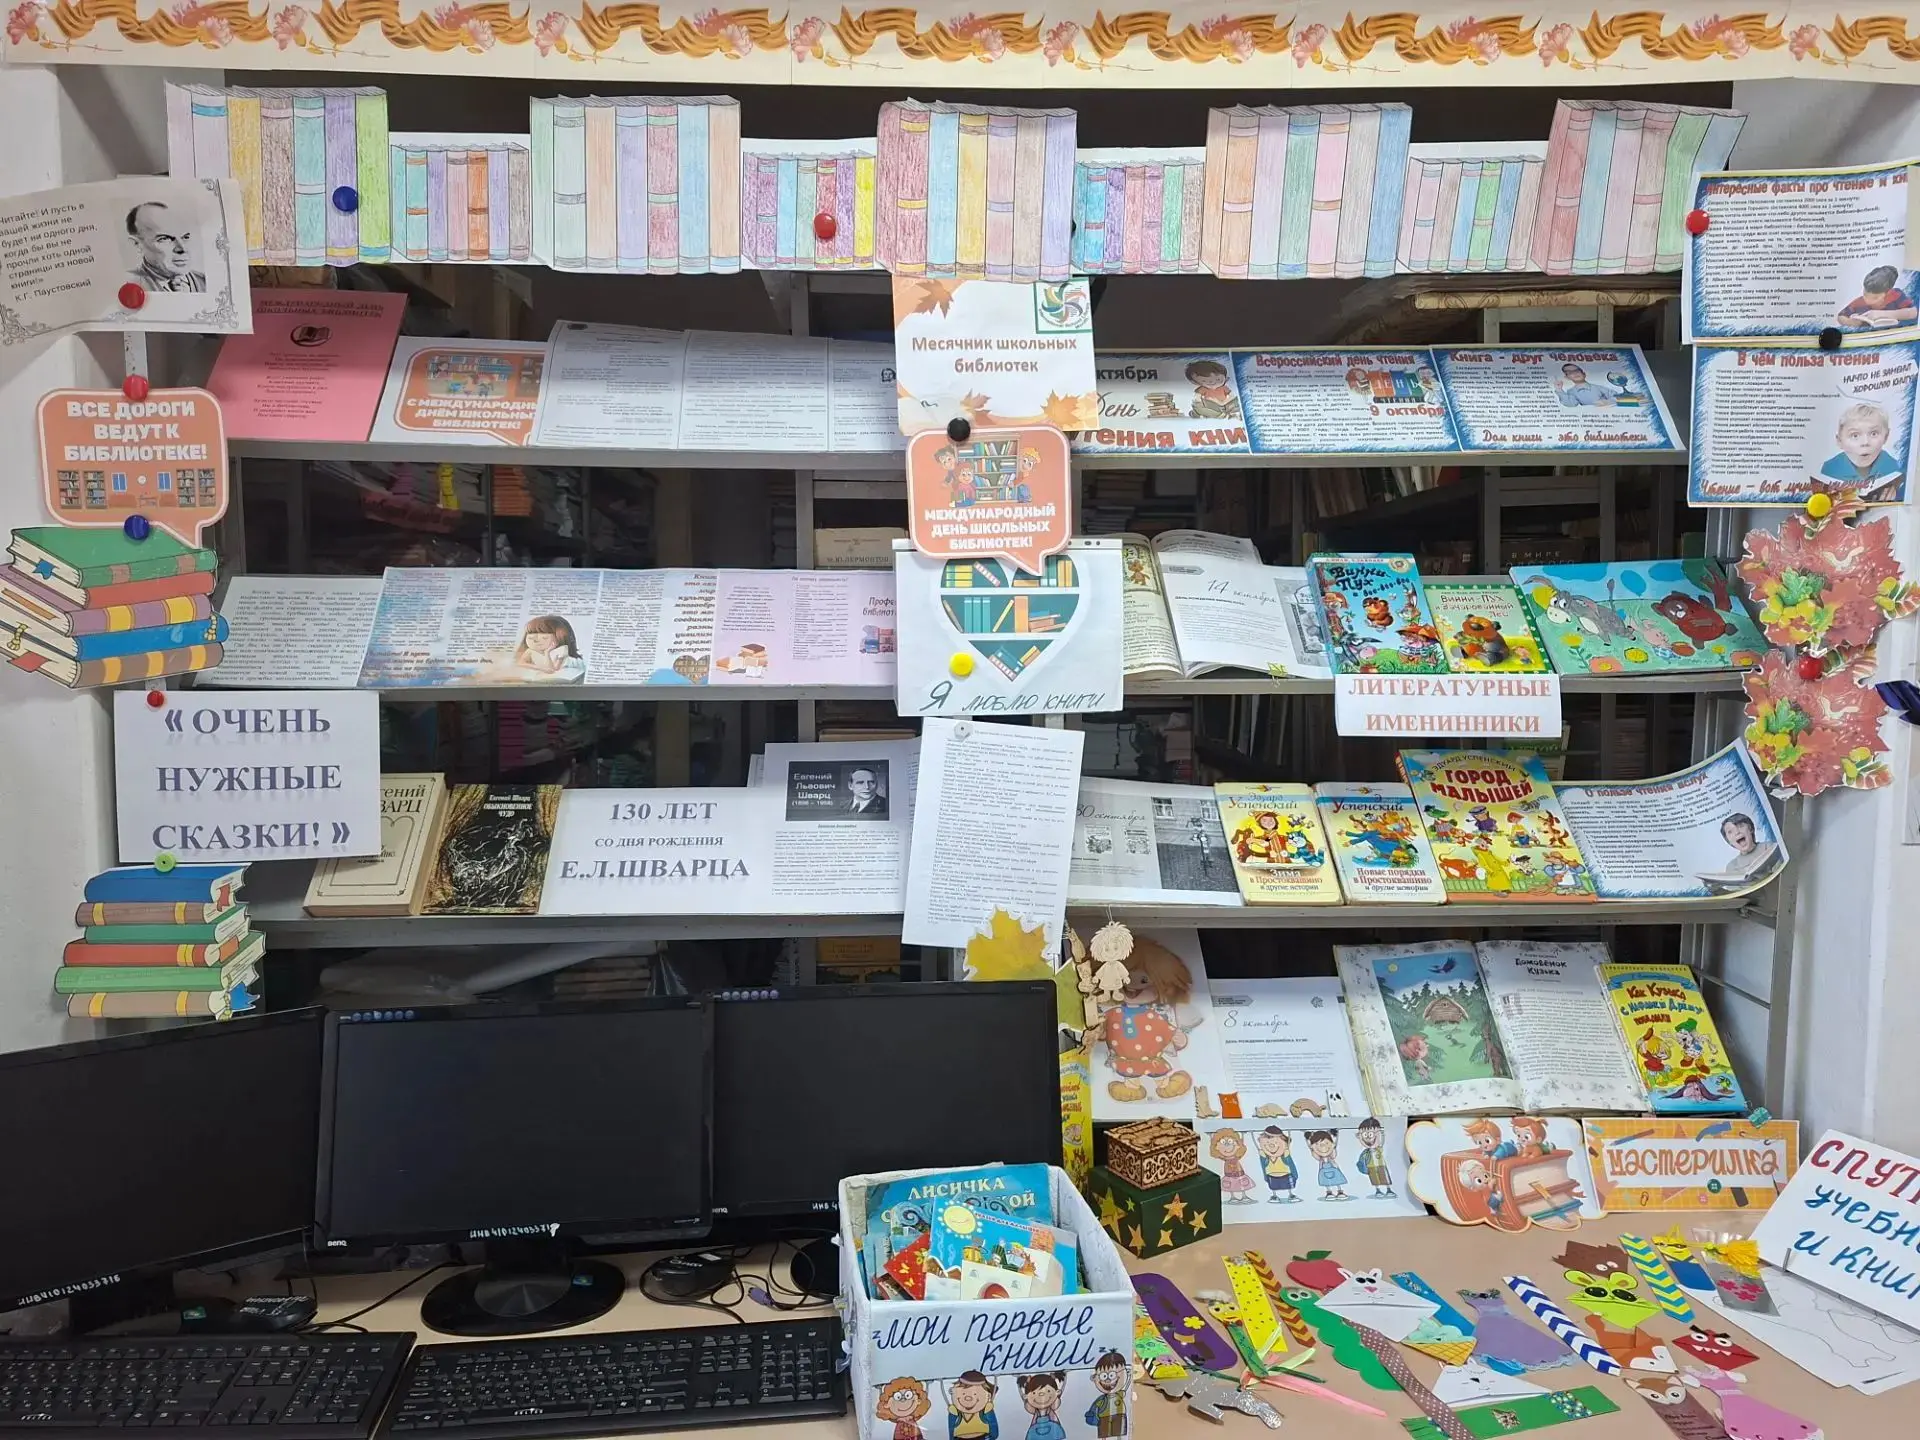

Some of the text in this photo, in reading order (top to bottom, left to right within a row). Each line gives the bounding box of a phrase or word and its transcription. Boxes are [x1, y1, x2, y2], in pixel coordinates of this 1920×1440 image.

[1772, 182, 1805, 195] факты
[1810, 181, 1828, 195] про
[1833, 178, 1873, 191] чтение
[1879, 177, 1887, 187] и
[40, 207, 49, 217] И
[50, 204, 77, 215] пусть
[31, 218, 60, 230] жизни
[60, 216, 73, 225] не
[1, 224, 98, 249] будет ни одного дня,
[3, 238, 72, 259] когда бы вы не
[6, 245, 92, 270] прочли хоть одной
[8, 264, 53, 280] страницы
[67, 255, 95, 267] новой
[34, 279, 92, 297] Паустовский
[912, 337, 1077, 352] Месячник школьных
[954, 358, 1039, 373] библиотек
[1256, 355, 1416, 368] Всероссийский день чтения
[1450, 351, 1493, 363] Книга
[1511, 352, 1543, 365] друг
[1737, 352, 1880, 368] В чём польза чтения
[1096, 366, 1158, 382] ктября
[1871, 371, 1881, 379] НЕ
[67, 401, 195, 420] ВСЕ ДОРОГИ
[407, 400, 417, 408] С
[1369, 404, 1445, 418] 9 октября
[94, 423, 180, 442] ВЕДУТ К
[432, 420, 522, 430] БИБЛИОТЕК!
[1482, 429, 1507, 442] Дом
[1512, 433, 1542, 442] книги
[1558, 431, 1579, 442] это
[64, 444, 208, 461] БИБЛИОТЕКЕ!
[1701, 479, 1741, 496] Чтение
[1759, 479, 1782, 493] вот
[924, 503, 1056, 523] МЕЖДУНАРОДНЫЙ
[931, 520, 1050, 538] ДЕНЬ ШКОЛЬНЫХ
[950, 536, 1033, 550] БИБЛИОТЕК!
[1207, 579, 1231, 594] 14
[1336, 577, 1374, 591] Пух
[920, 681, 953, 711] Я
[1348, 678, 1552, 697] ЛИТЕРАТУРНЫЕ
[1366, 714, 1540, 733] ИМЕНИННИКИ
[157, 764, 342, 792] НУЖНЫЕ
[1446, 768, 1512, 787] ГОРОД
[1585, 789, 1593, 797] О
[1636, 783, 1673, 796] чтения
[1678, 773, 1708, 790] вслух
[798, 792, 831, 801] Шварц
[1430, 778, 1533, 804] МАЛЫШЕЙ
[1229, 796, 1298, 809] Успенский
[1333, 800, 1404, 813] Успенский
[610, 803, 718, 820] 130 ЛЕТ
[595, 836, 724, 848] СО ДНЯ РОЖДЕНИЯ
[559, 859, 751, 881] Е.Л.ШВАРЦА
[1357, 868, 1426, 878] Новые порядки
[1360, 876, 1432, 885] Простоквашино
[1223, 1009, 1239, 1028] 8
[908, 1176, 1006, 1202] ЛИСИЧКА
[1804, 1183, 1920, 1254] учебн
[1794, 1230, 1831, 1257] и
[965, 1306, 1094, 1343] первые
